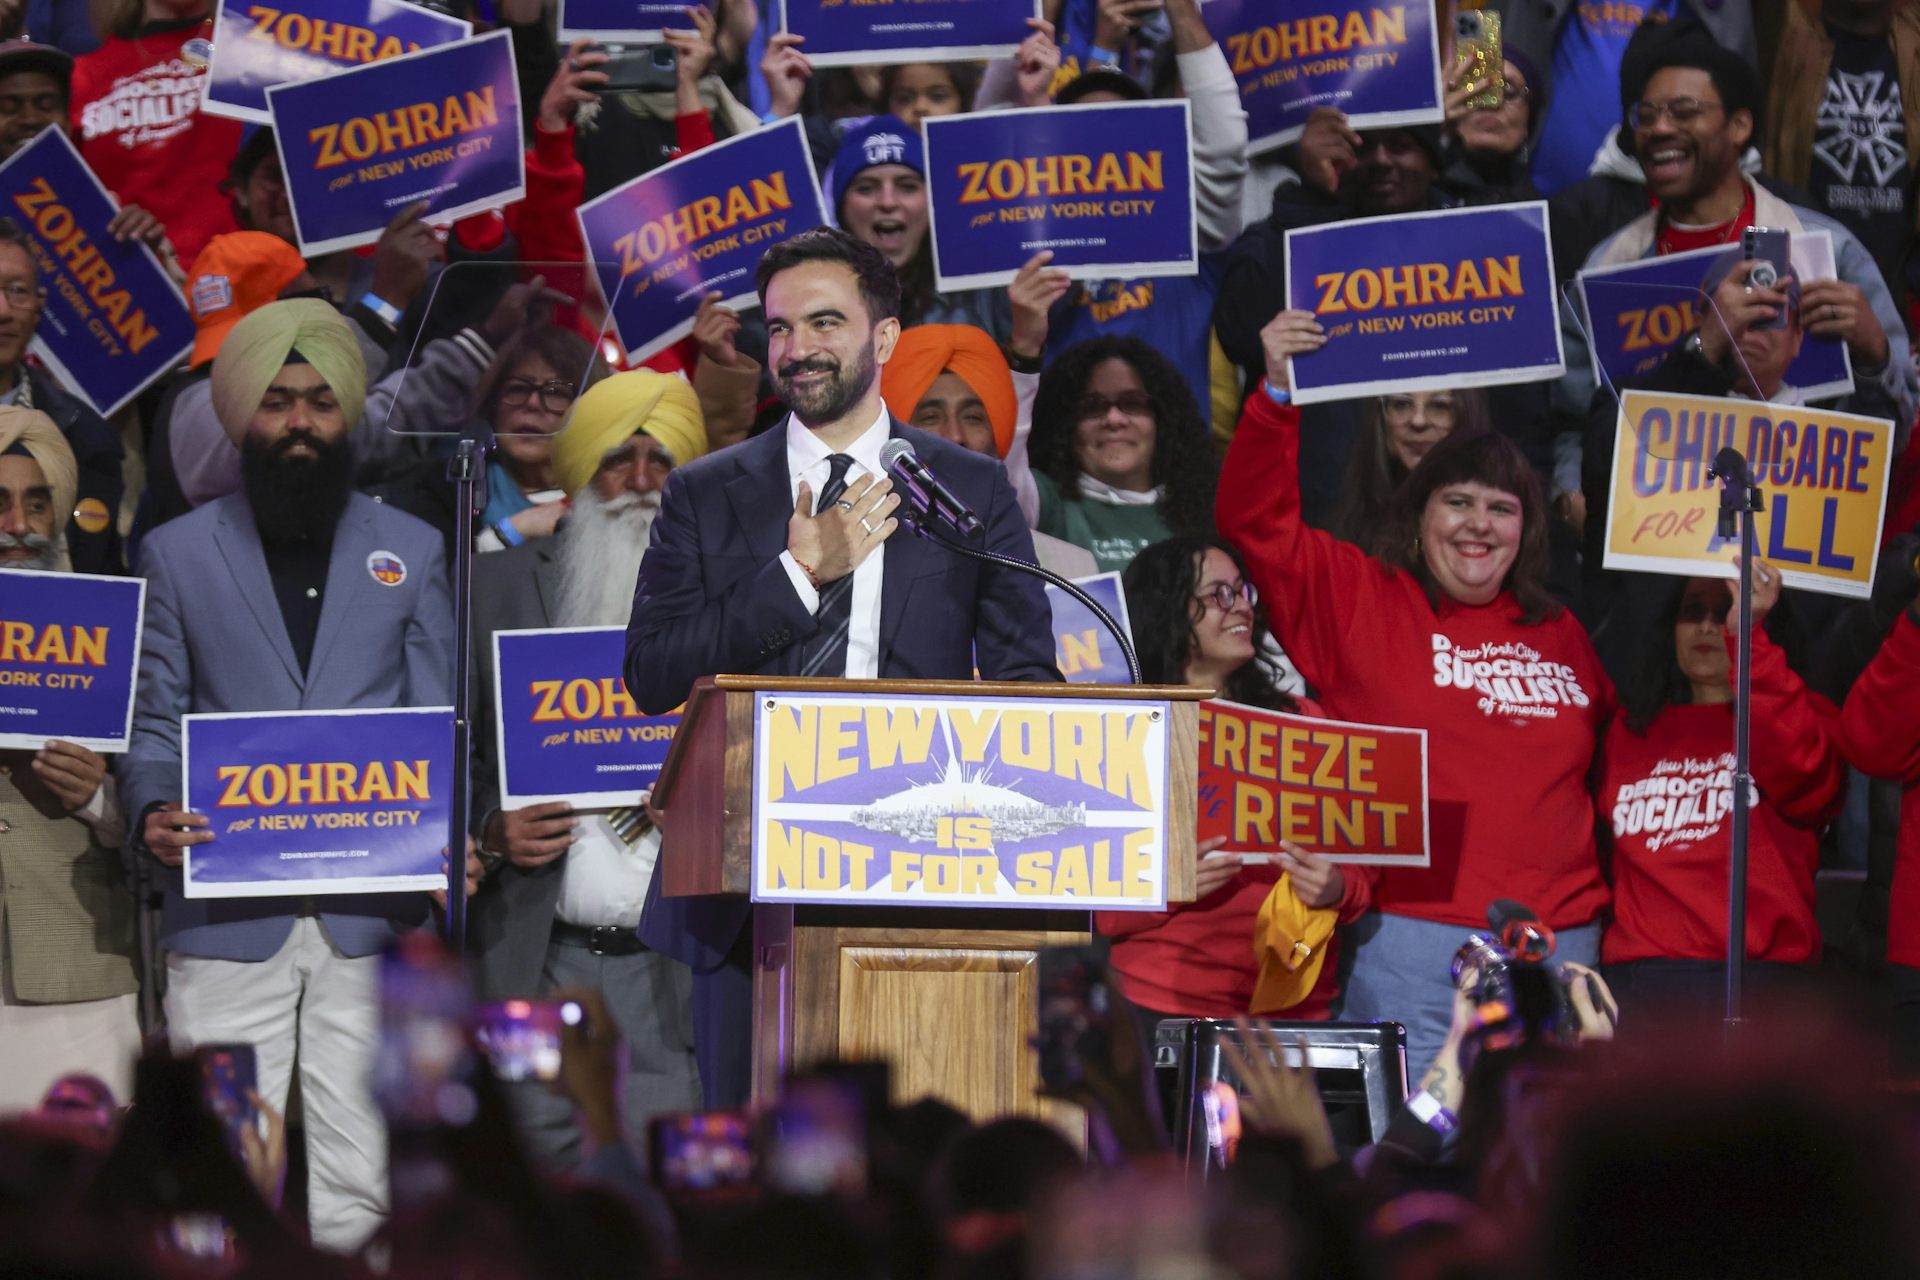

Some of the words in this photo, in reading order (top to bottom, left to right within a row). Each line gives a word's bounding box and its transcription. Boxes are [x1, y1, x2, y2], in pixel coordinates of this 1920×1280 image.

[247, 5, 424, 63] ZOHRA
[1226, 5, 1408, 75] ZOHRAN
[1263, 66, 1298, 88] NEW
[1302, 57, 1351, 76] YORK
[1355, 52, 1399, 71] CITY
[308, 84, 499, 170] ZOHRAN
[358, 159, 405, 182] NEW
[408, 147, 456, 170] YORK
[455, 135, 494, 158] CITY
[866, 146, 904, 164] UFT
[957, 149, 1165, 205] ZOHRAN
[613, 170, 792, 277] ZOHRAN
[999, 204, 1047, 223] NEW
[1051, 201, 1105, 219] YORK
[1109, 199, 1155, 216] CITY
[12, 175, 161, 356] ZOHRAN
[652, 254, 690, 284] NEW
[691, 232, 741, 263] YORK
[742, 218, 788, 245] CITY
[1314, 255, 1525, 315] ZOHRAN
[1358, 315, 1406, 335] NEW
[1409, 311, 1465, 331] YORK
[1469, 305, 1517, 323] CITY
[1631, 506, 1706, 544] FOR
[1481, 641, 1515, 660] York
[1514, 641, 1542, 663] City
[46, 673, 95, 690] CITY
[529, 676, 687, 723] ZOH
[1477, 696, 1497, 717] of
[1498, 701, 1558, 719] America
[542, 732, 570, 749] FOR
[574, 727, 624, 745] NEW
[767, 704, 938, 804] NEW
[947, 708, 1154, 813] YORK
[1199, 708, 1378, 795] FREEZE
[216, 759, 432, 808] ZOHRAN
[226, 817, 255, 834] FOR
[258, 813, 309, 831] NEW
[312, 811, 369, 829] YORK
[372, 809, 421, 826] CITY
[937, 815, 992, 850] IS
[1234, 780, 1409, 848] RENT
[766, 818, 875, 892] NOT
[890, 850, 999, 895] FOR
[1015, 827, 1154, 900] SALE
